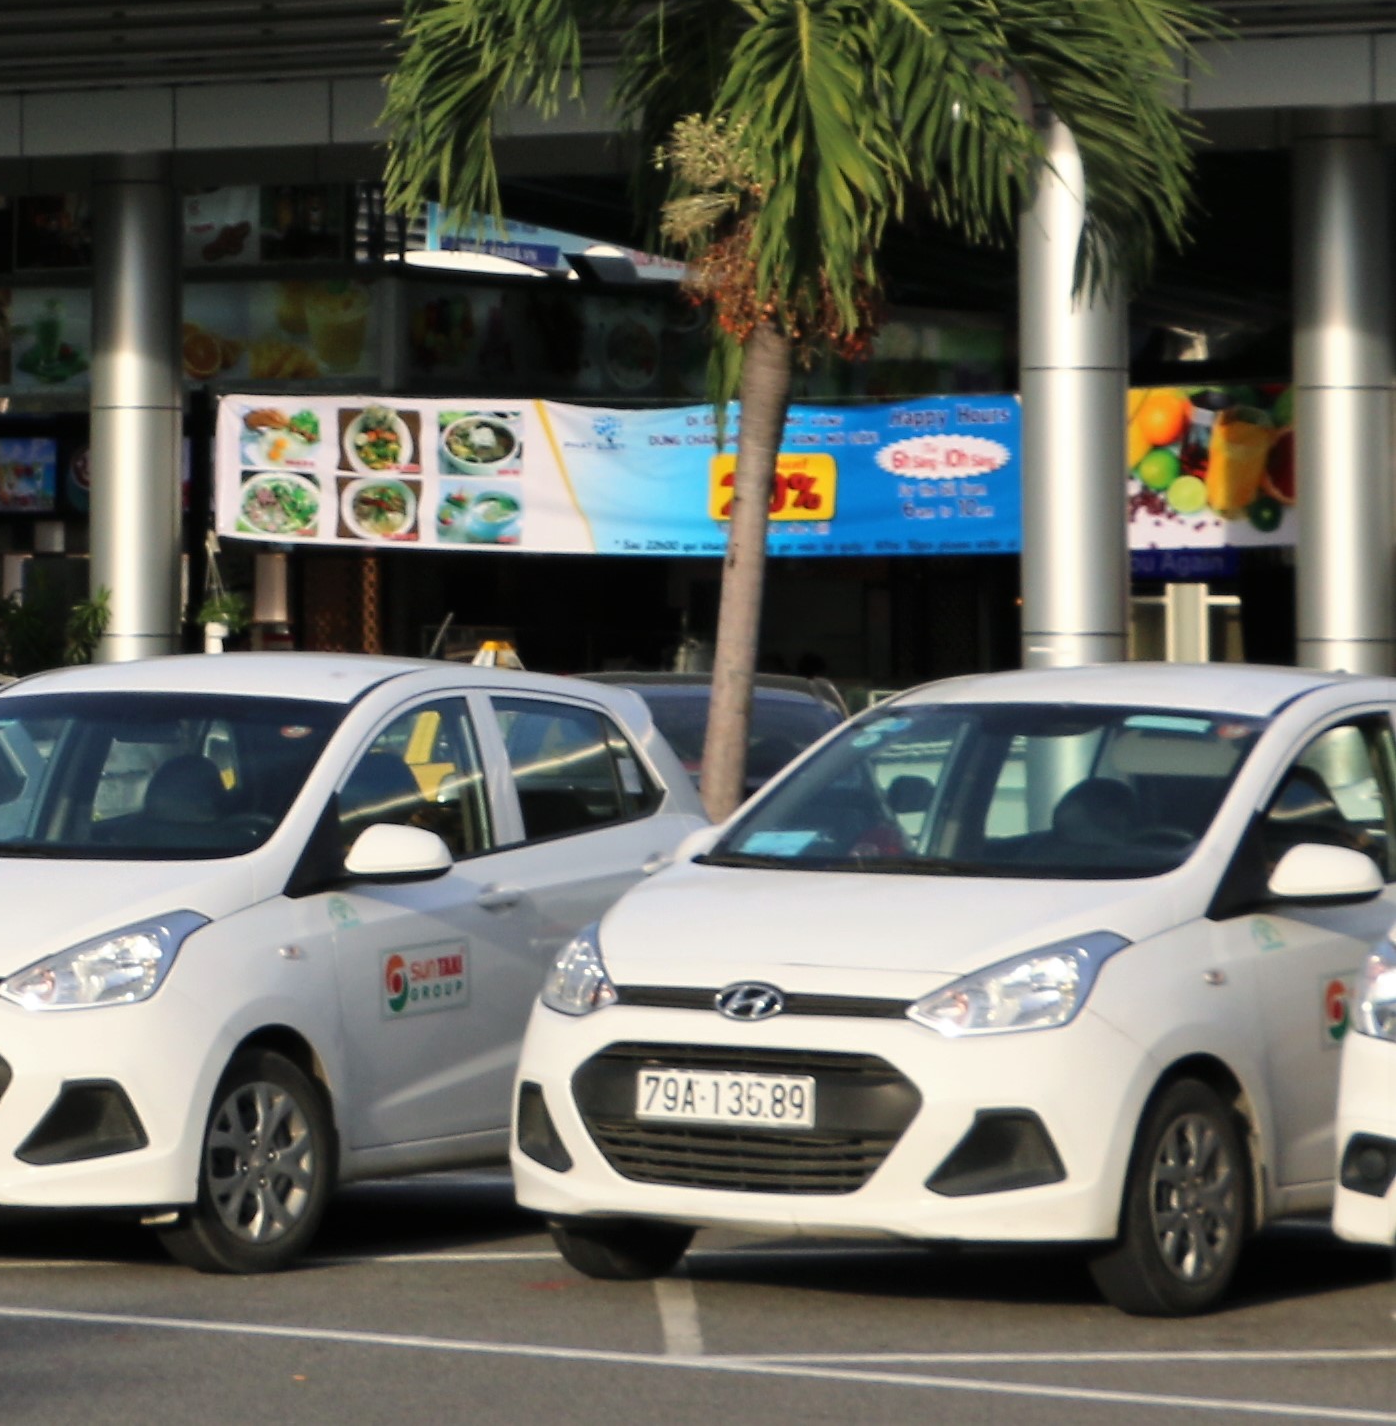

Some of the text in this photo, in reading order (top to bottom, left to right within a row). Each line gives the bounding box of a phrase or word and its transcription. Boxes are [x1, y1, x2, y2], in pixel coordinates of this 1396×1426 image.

[890, 403, 1010, 429] Happy Hours
[409, 980, 464, 1001] GROUP
